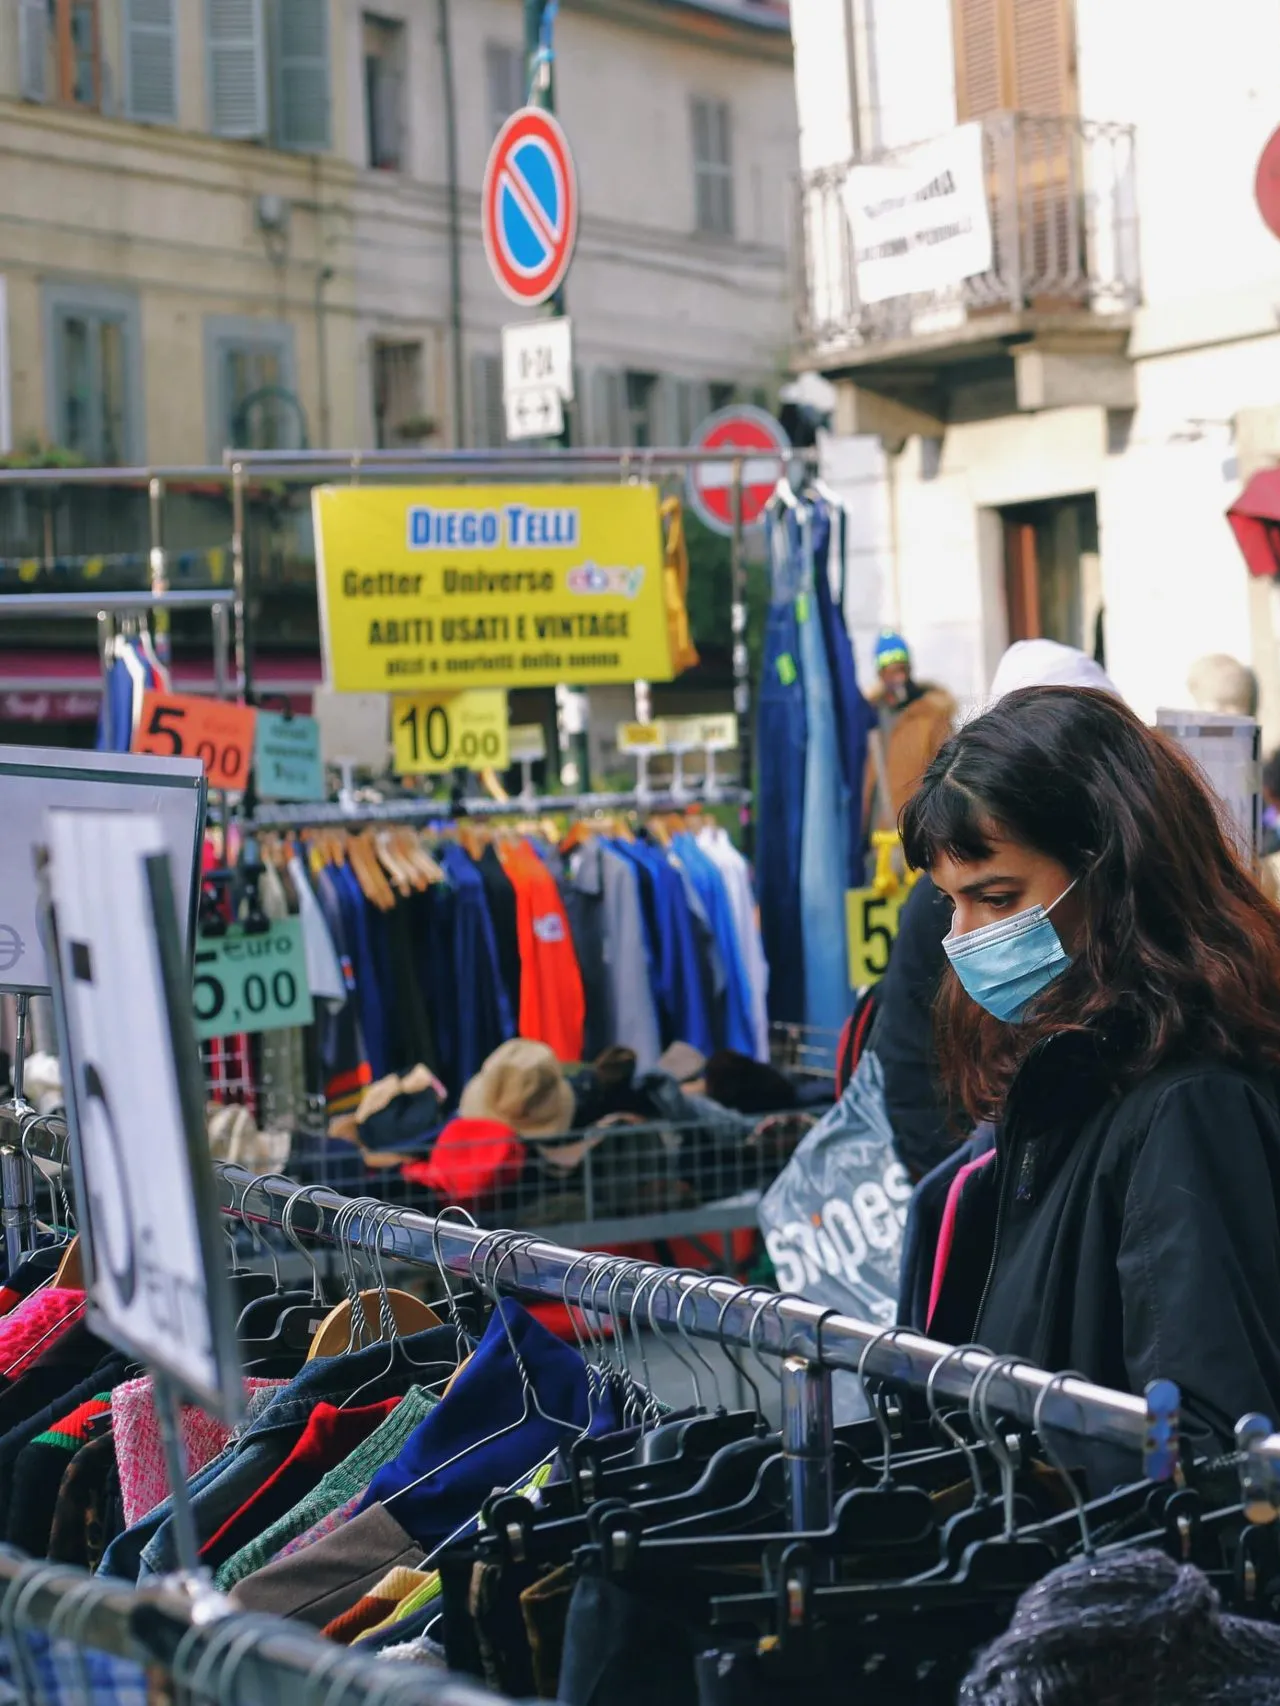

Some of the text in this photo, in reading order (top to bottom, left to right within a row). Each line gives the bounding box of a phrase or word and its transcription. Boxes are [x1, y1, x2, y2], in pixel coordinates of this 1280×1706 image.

[411, 506, 575, 546] DIEGO TELLI
[369, 611, 630, 646] ABITI USATI E VINTAGE
[863, 897, 893, 975] 5
